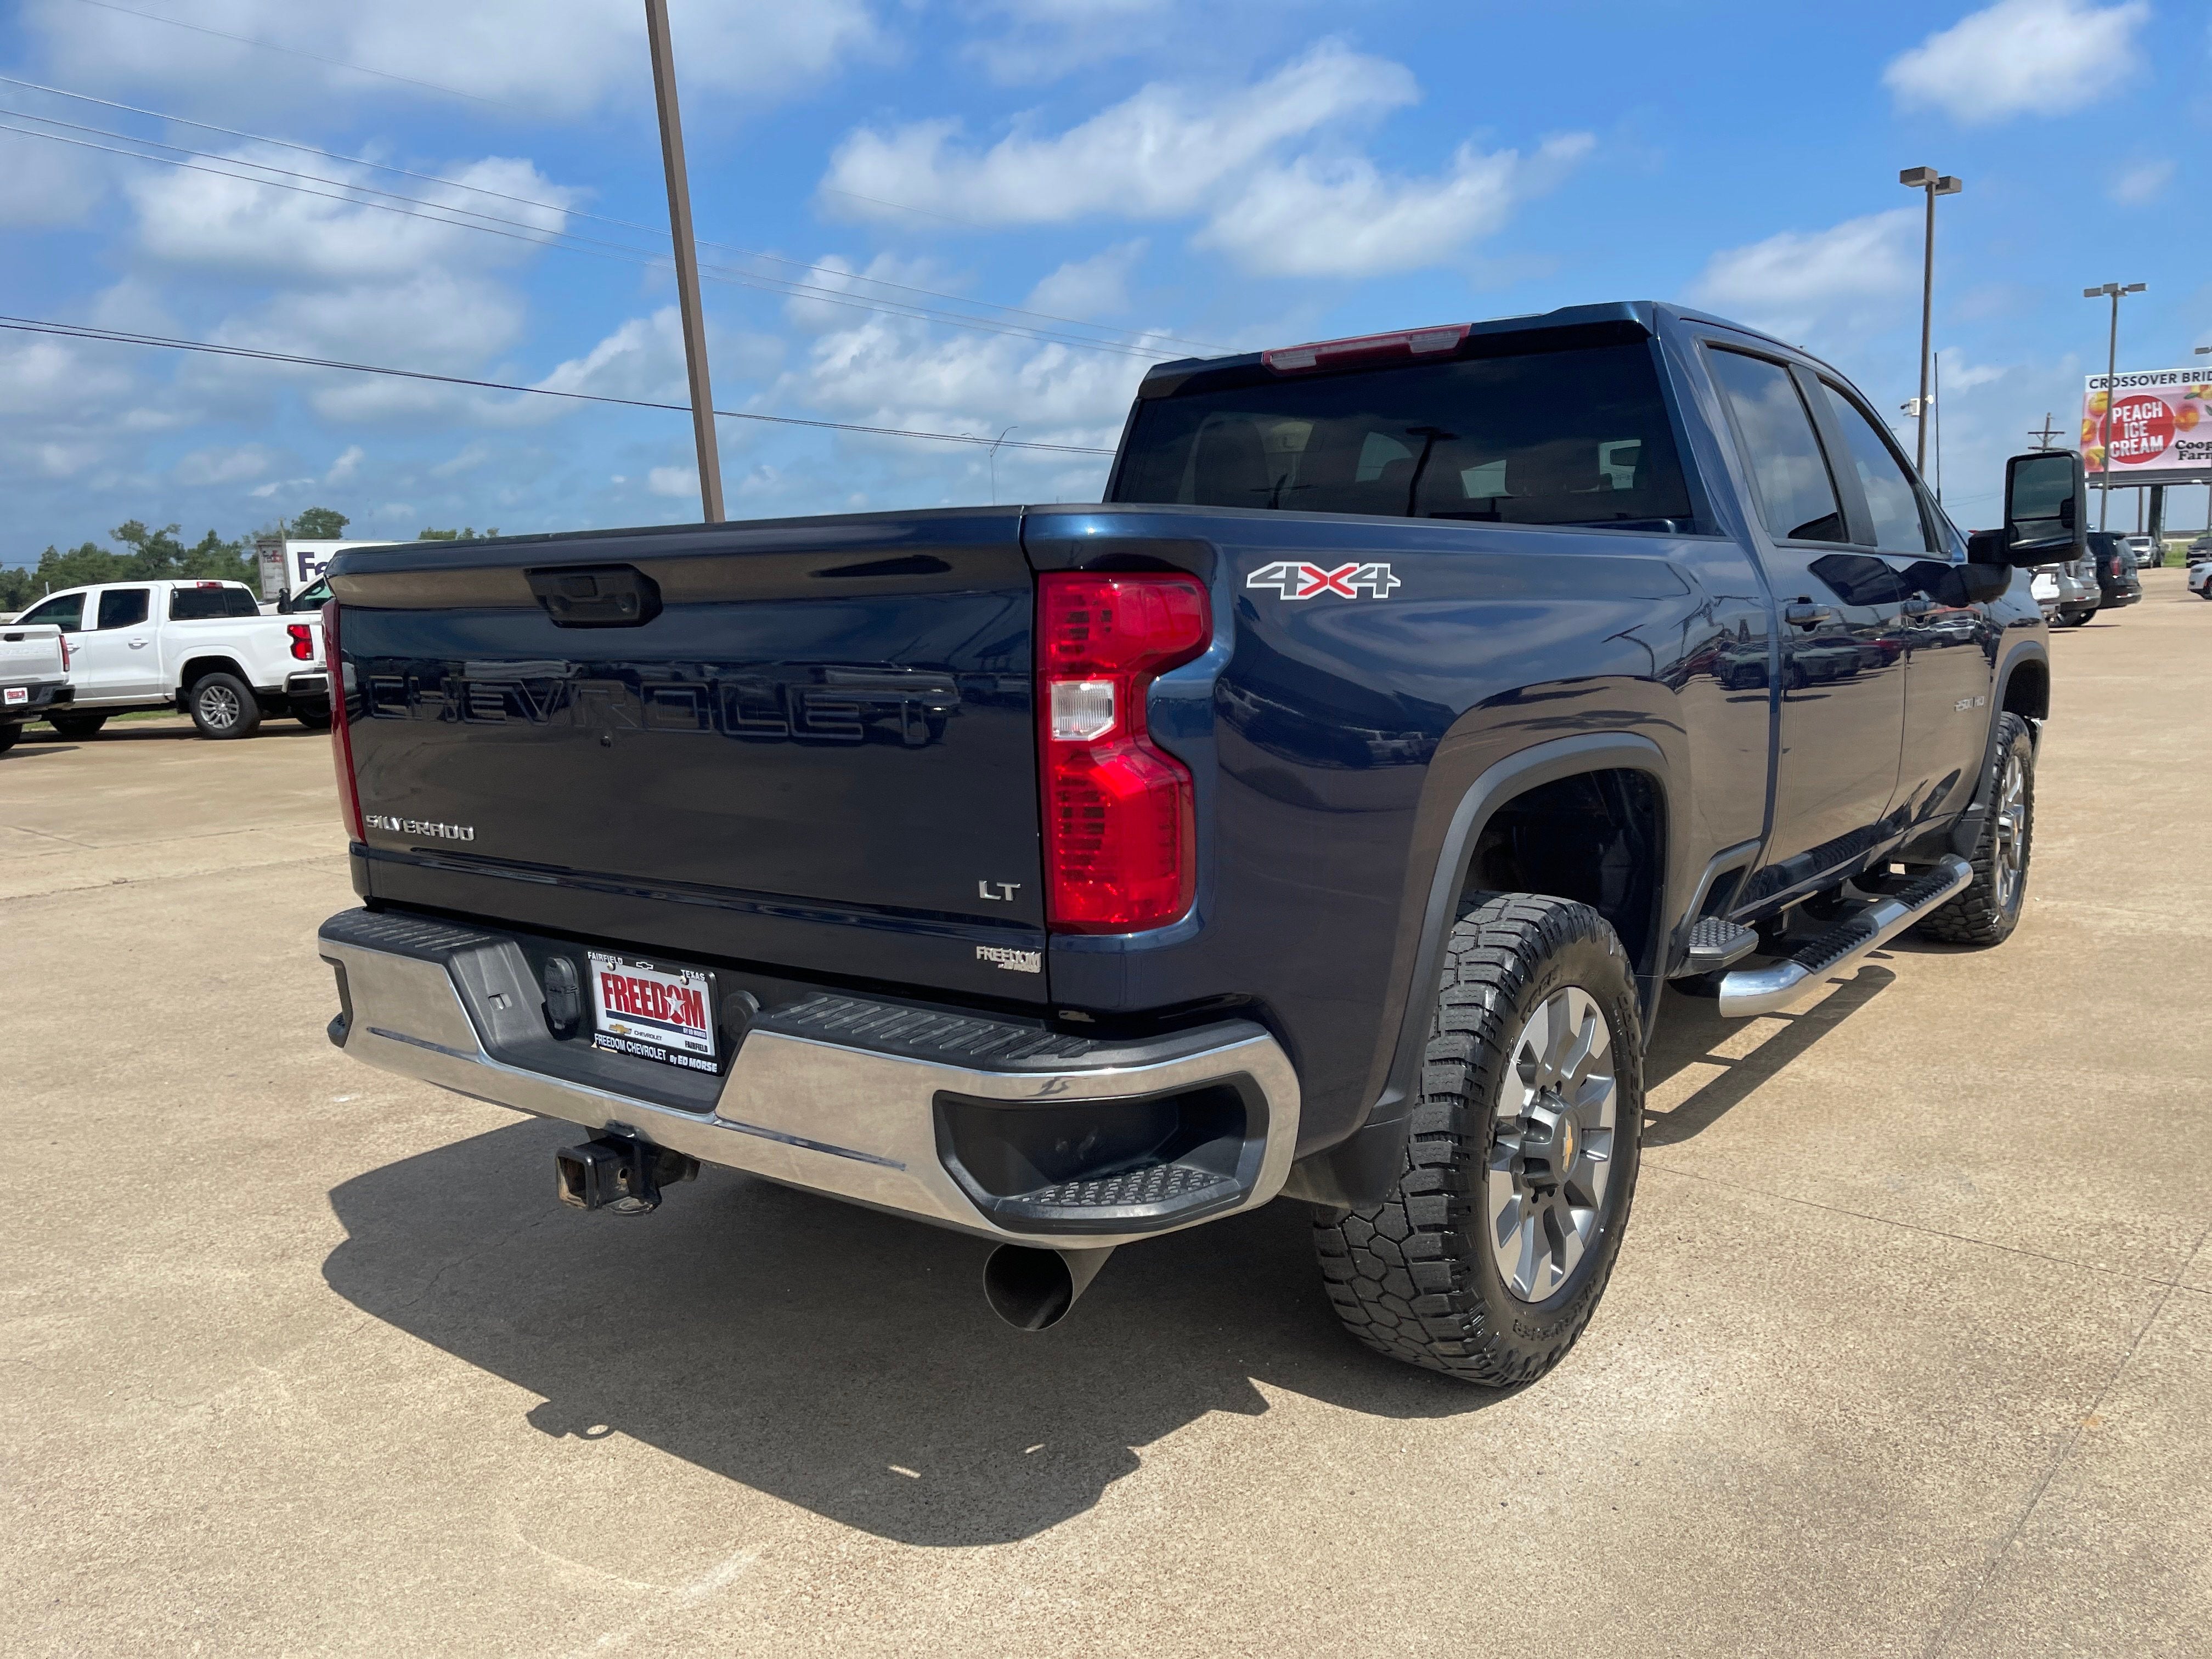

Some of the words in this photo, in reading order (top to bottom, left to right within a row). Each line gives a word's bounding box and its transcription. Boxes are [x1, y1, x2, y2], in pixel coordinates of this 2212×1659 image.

[2089, 373, 2177, 388] CROSSOVER
[2112, 401, 2163, 424] PEACH
[2124, 420, 2149, 439] ICE
[2109, 435, 2164, 458] CREAM
[366, 674, 961, 744] CHEVROLET
[365, 815, 476, 841] SILVERADO
[979, 880, 1022, 901] LT
[587, 951, 623, 965] FAIRFIELD
[680, 969, 706, 981] TEXAS
[976, 946, 1042, 967] FREEDOM
[600, 972, 706, 1030] FREEDOM
[634, 1030, 662, 1041] CHEVROLET
[594, 1033, 626, 1052] FREEDOM
[627, 1041, 667, 1060] CHEVROLET
[678, 1055, 688, 1066] ED
[689, 1057, 717, 1073] MORSE
